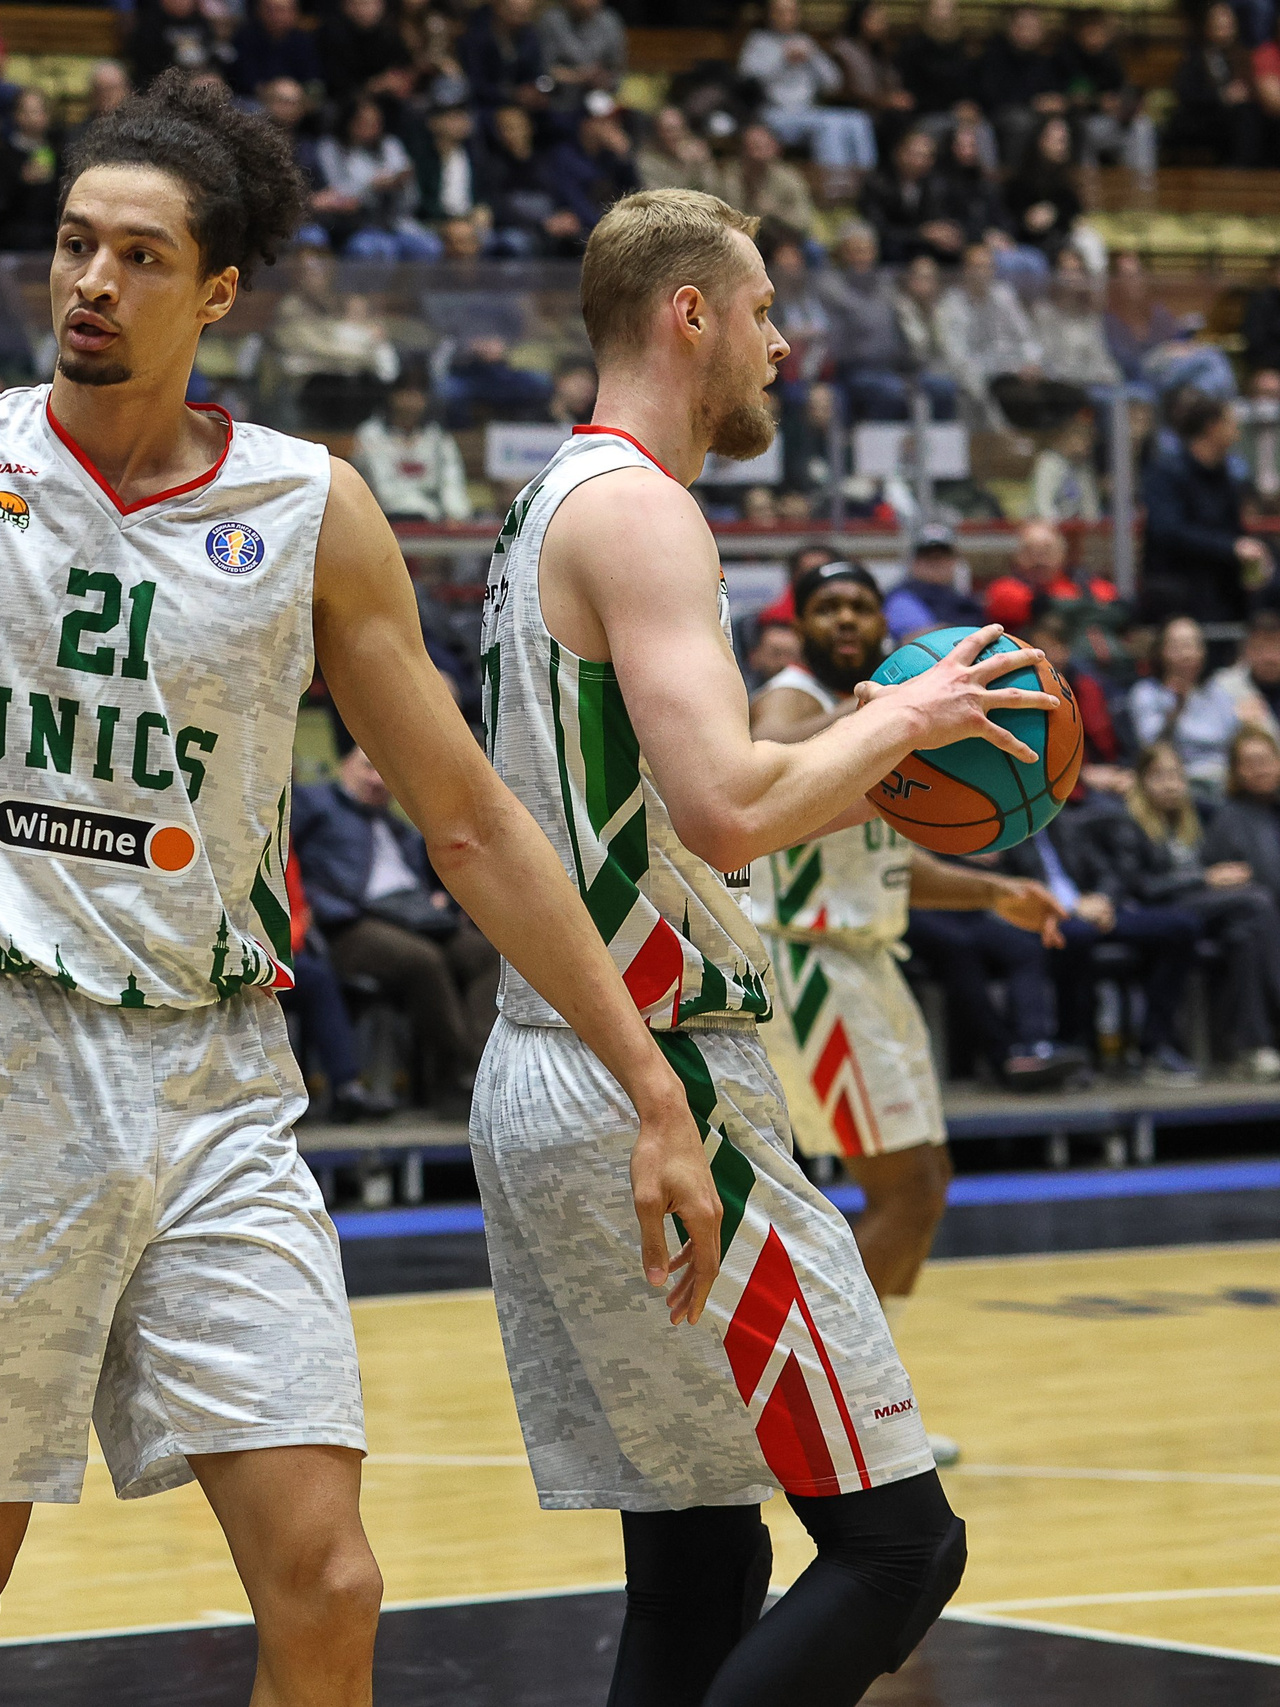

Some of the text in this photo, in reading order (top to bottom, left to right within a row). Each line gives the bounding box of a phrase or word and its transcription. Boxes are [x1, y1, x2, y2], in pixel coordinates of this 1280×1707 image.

[236, 524, 253, 535] ЛИГА
[217, 561, 239, 573] UNITED
[238, 560, 259, 573] LEAGUE
[57, 567, 156, 681] 21
[6, 808, 137, 856] Winline
[874, 1398, 914, 1420] MAXX
